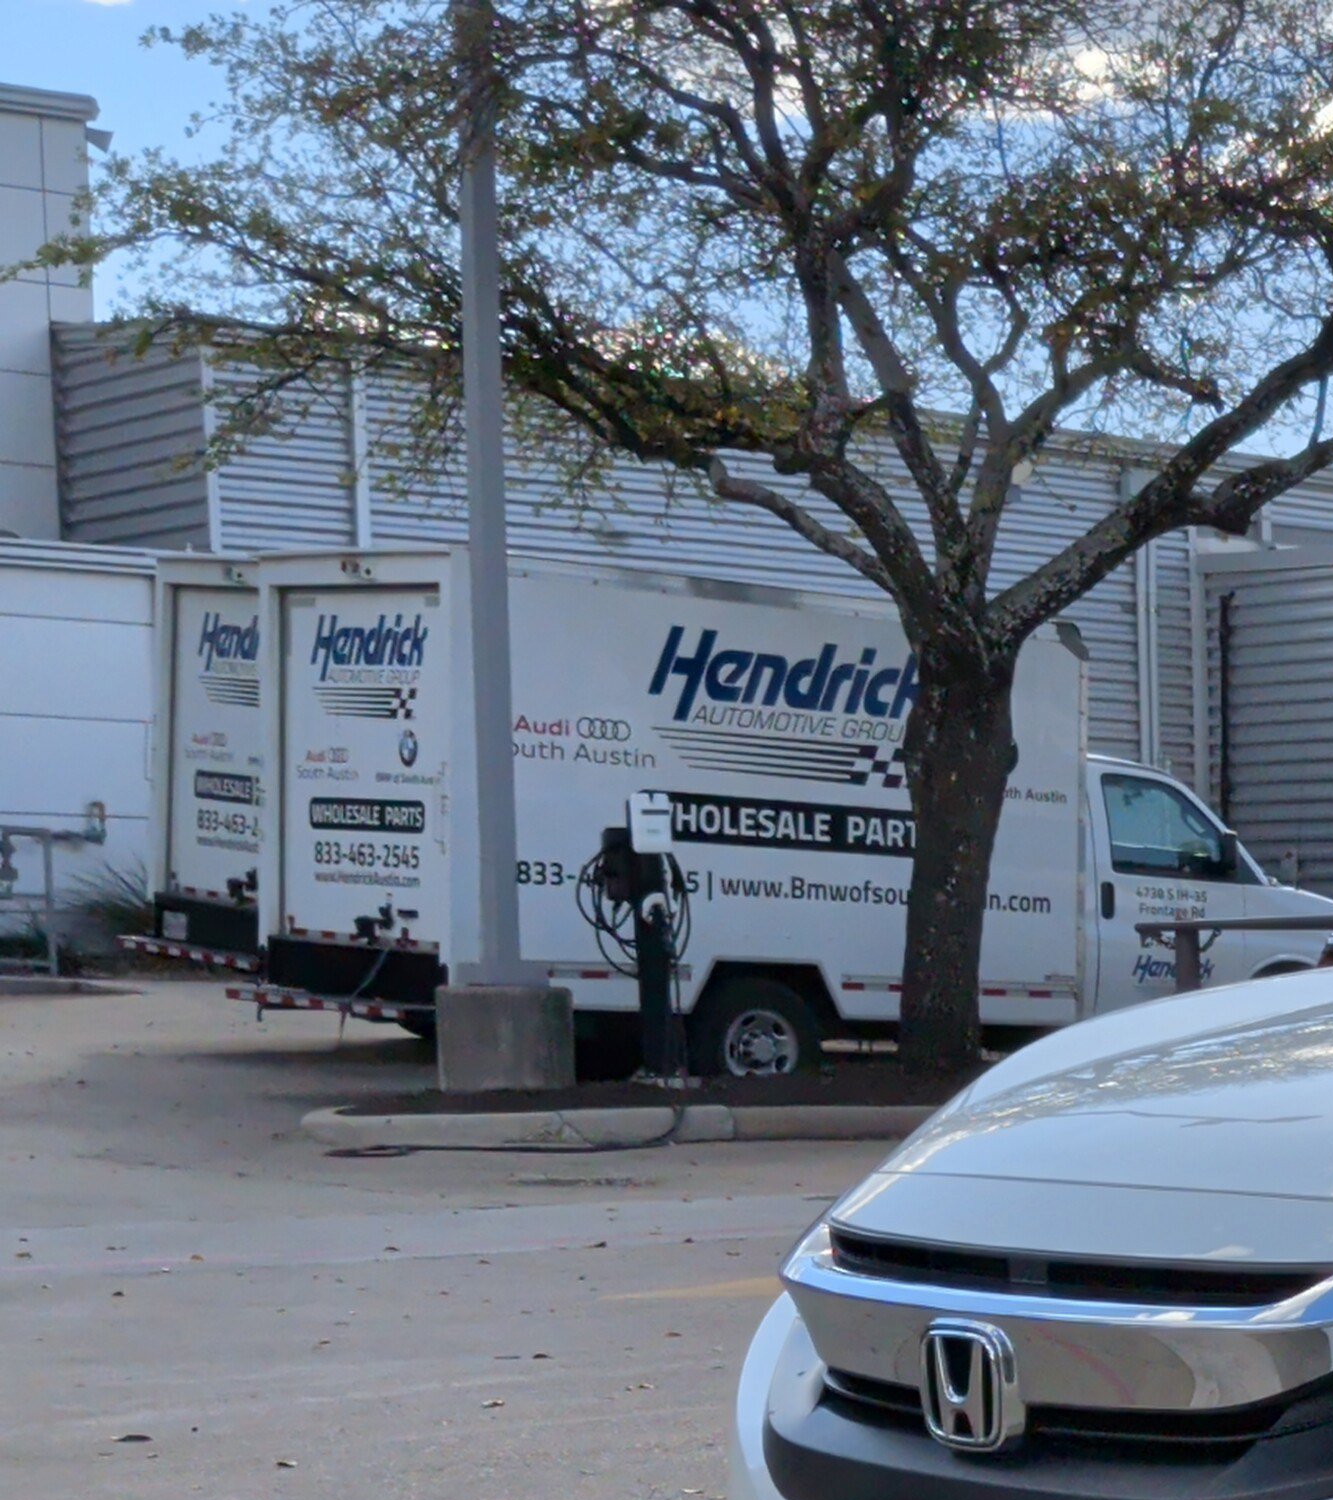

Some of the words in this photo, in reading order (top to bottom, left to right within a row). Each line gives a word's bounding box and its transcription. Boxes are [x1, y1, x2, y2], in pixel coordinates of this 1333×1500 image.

[198, 611, 259, 671] Hend
[310, 613, 429, 681] Hendrick
[514, 714, 570, 736] Audi
[692, 704, 836, 736] AUTOMOTIVE
[841, 718, 905, 742] GROU
[573, 743, 657, 768] Austin
[296, 764, 325, 779] South
[1025, 788, 1068, 803] Austin
[312, 803, 381, 826] WHOLESALE
[384, 806, 423, 828] PARTS
[673, 801, 832, 842] HOLESALE
[846, 815, 917, 848] PART
[314, 840, 420, 870] 833-463-2545
[1190, 906, 1206, 919] Rd
